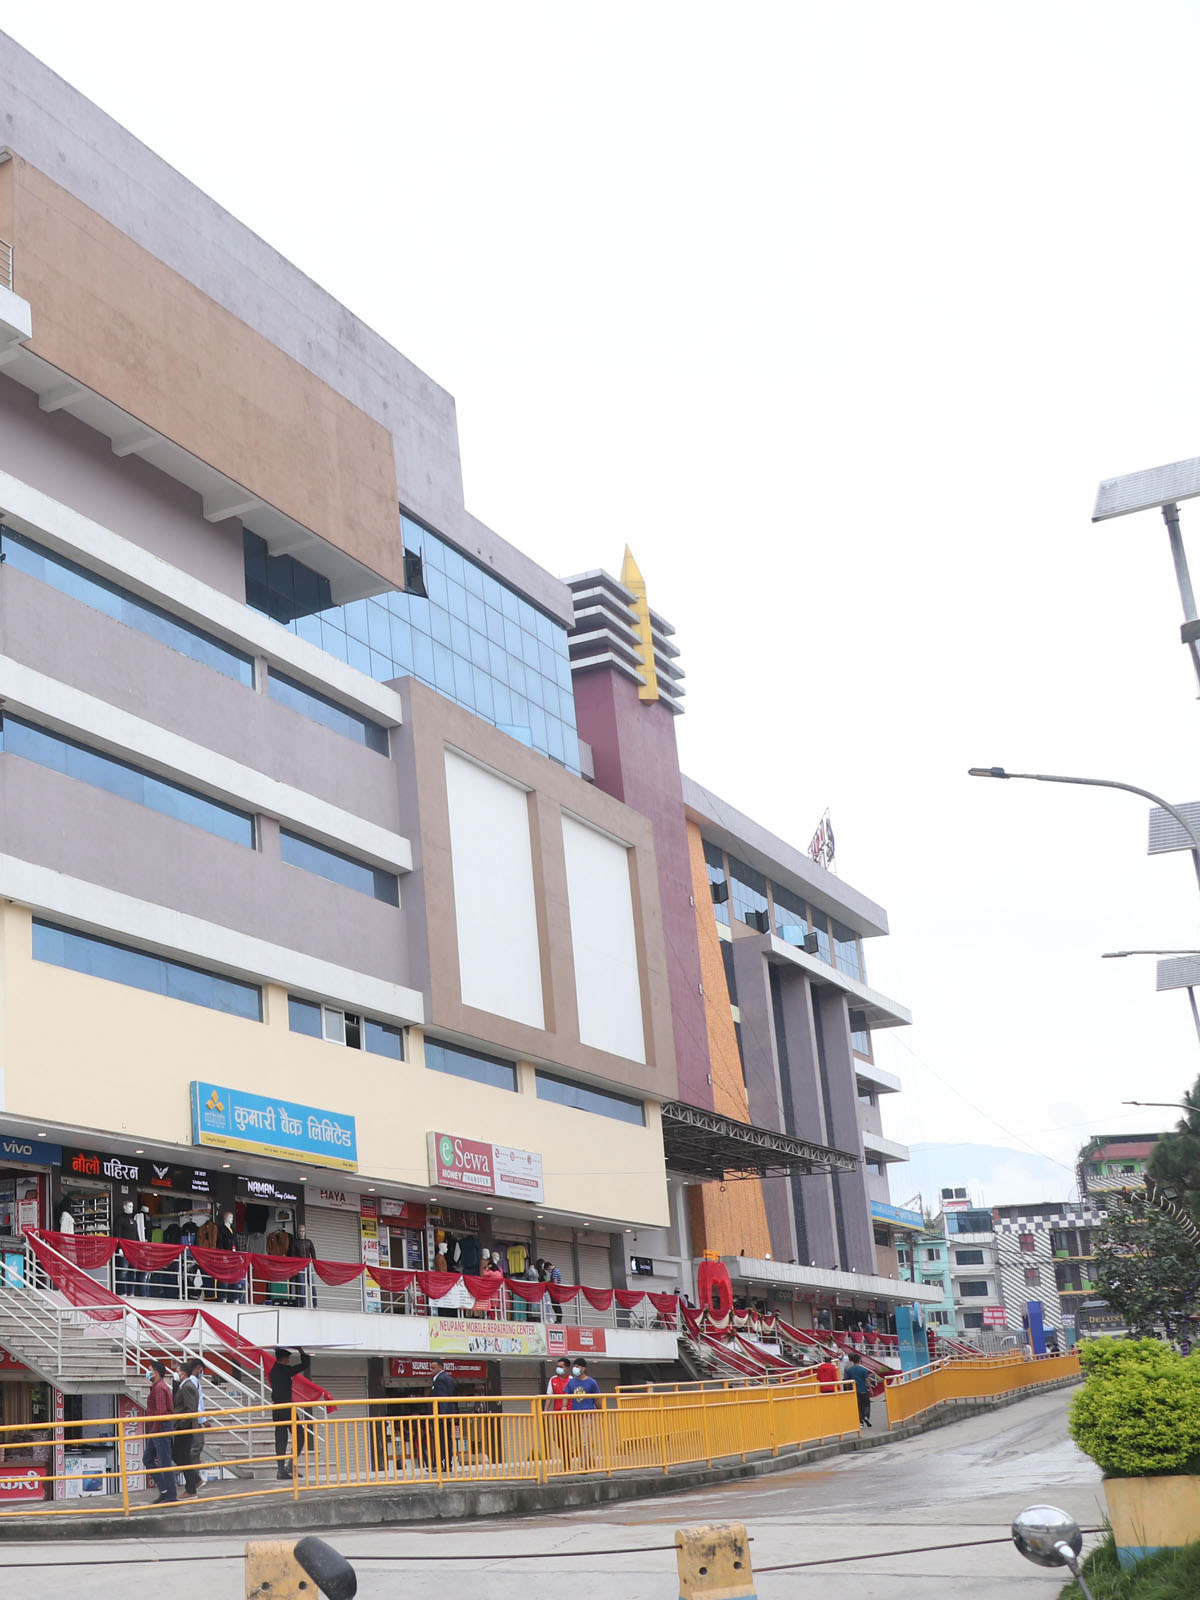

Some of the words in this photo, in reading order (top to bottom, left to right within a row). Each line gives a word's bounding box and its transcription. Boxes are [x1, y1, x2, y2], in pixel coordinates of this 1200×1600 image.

[233, 1106, 276, 1131] कुमारी
[306, 1115, 352, 1147] लिमिटेड
[2, 1140, 33, 1156] vivo
[72, 1152, 101, 1175] नौलो
[103, 1158, 140, 1181] पहिरन
[442, 1169, 462, 1181] MONEY
[247, 1180, 275, 1195] NAMAN
[440, 1320, 466, 1332] NEUPANE
[466, 1322, 487, 1334] MOBILE
[516, 1324, 536, 1336] CENTER
